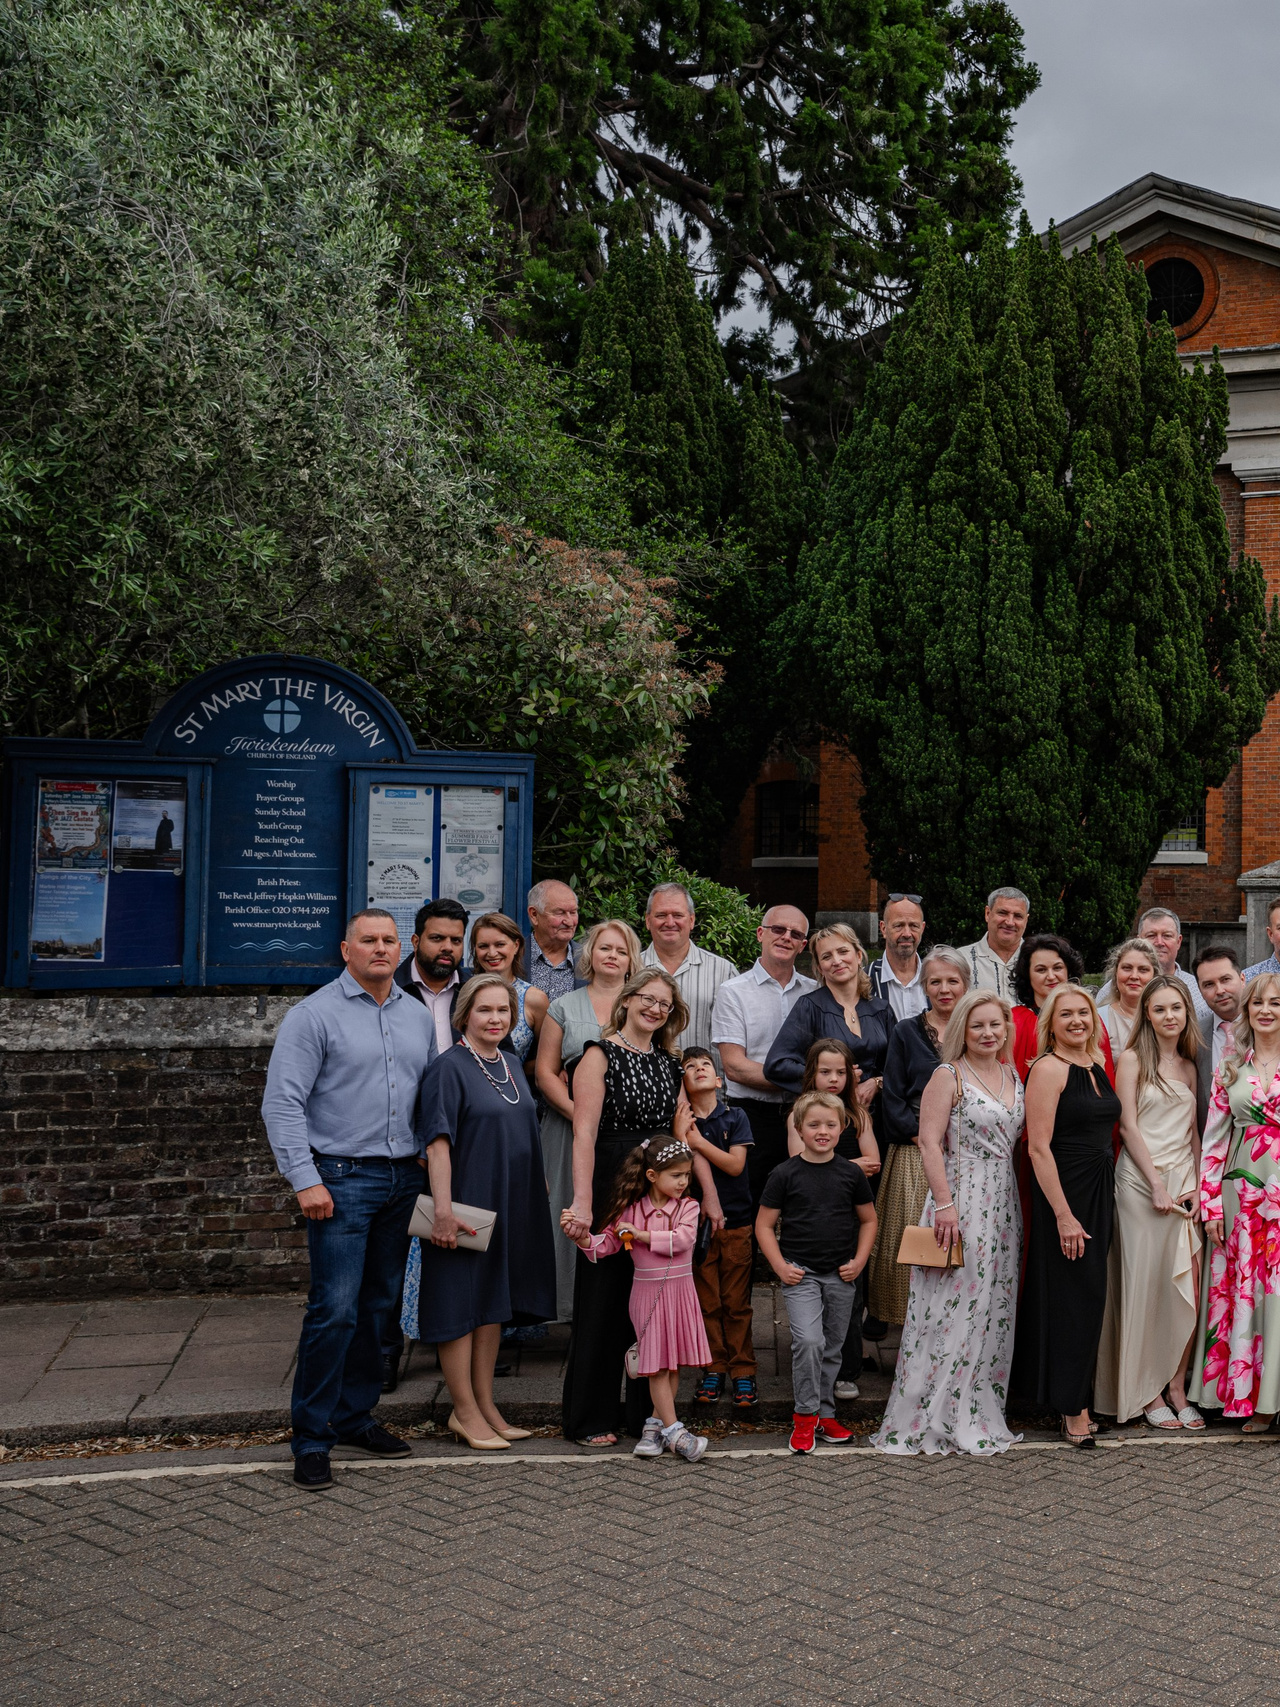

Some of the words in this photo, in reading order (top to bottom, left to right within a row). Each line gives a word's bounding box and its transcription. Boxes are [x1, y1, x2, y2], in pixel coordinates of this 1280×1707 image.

[174, 712, 204, 744] ST
[200, 679, 265, 721] MARY
[268, 677, 317, 700] THE
[324, 684, 386, 749] VIRGIN
[224, 736, 338, 756] Twickenham
[246, 752, 275, 760] CHURCH
[266, 780, 297, 790] Worship
[256, 793, 278, 803] Prayer
[278, 794, 305, 805] Groups
[254, 808, 281, 818] Sunday
[281, 808, 306, 817] School
[257, 822, 279, 830] Youth
[279, 822, 302, 833] Group
[254, 836, 290, 846] Reaching
[290, 836, 305, 844] Out
[241, 849, 253, 857] All
[253, 851, 271, 859] ages.
[283, 850, 317, 858] welcome.
[257, 878, 278, 886] Parish
[279, 878, 301, 886] Priest:
[217, 892, 233, 900] The
[233, 892, 253, 900] Revd.
[253, 892, 277, 902] Jeffrey
[278, 892, 306, 903] Hopkin
[306, 893, 338, 901] Williams
[224, 906, 246, 914] Parish
[246, 906, 271, 914] Office:
[311, 907, 330, 915] 2693
[232, 921, 321, 931] www.stmarytwick.org.uk
